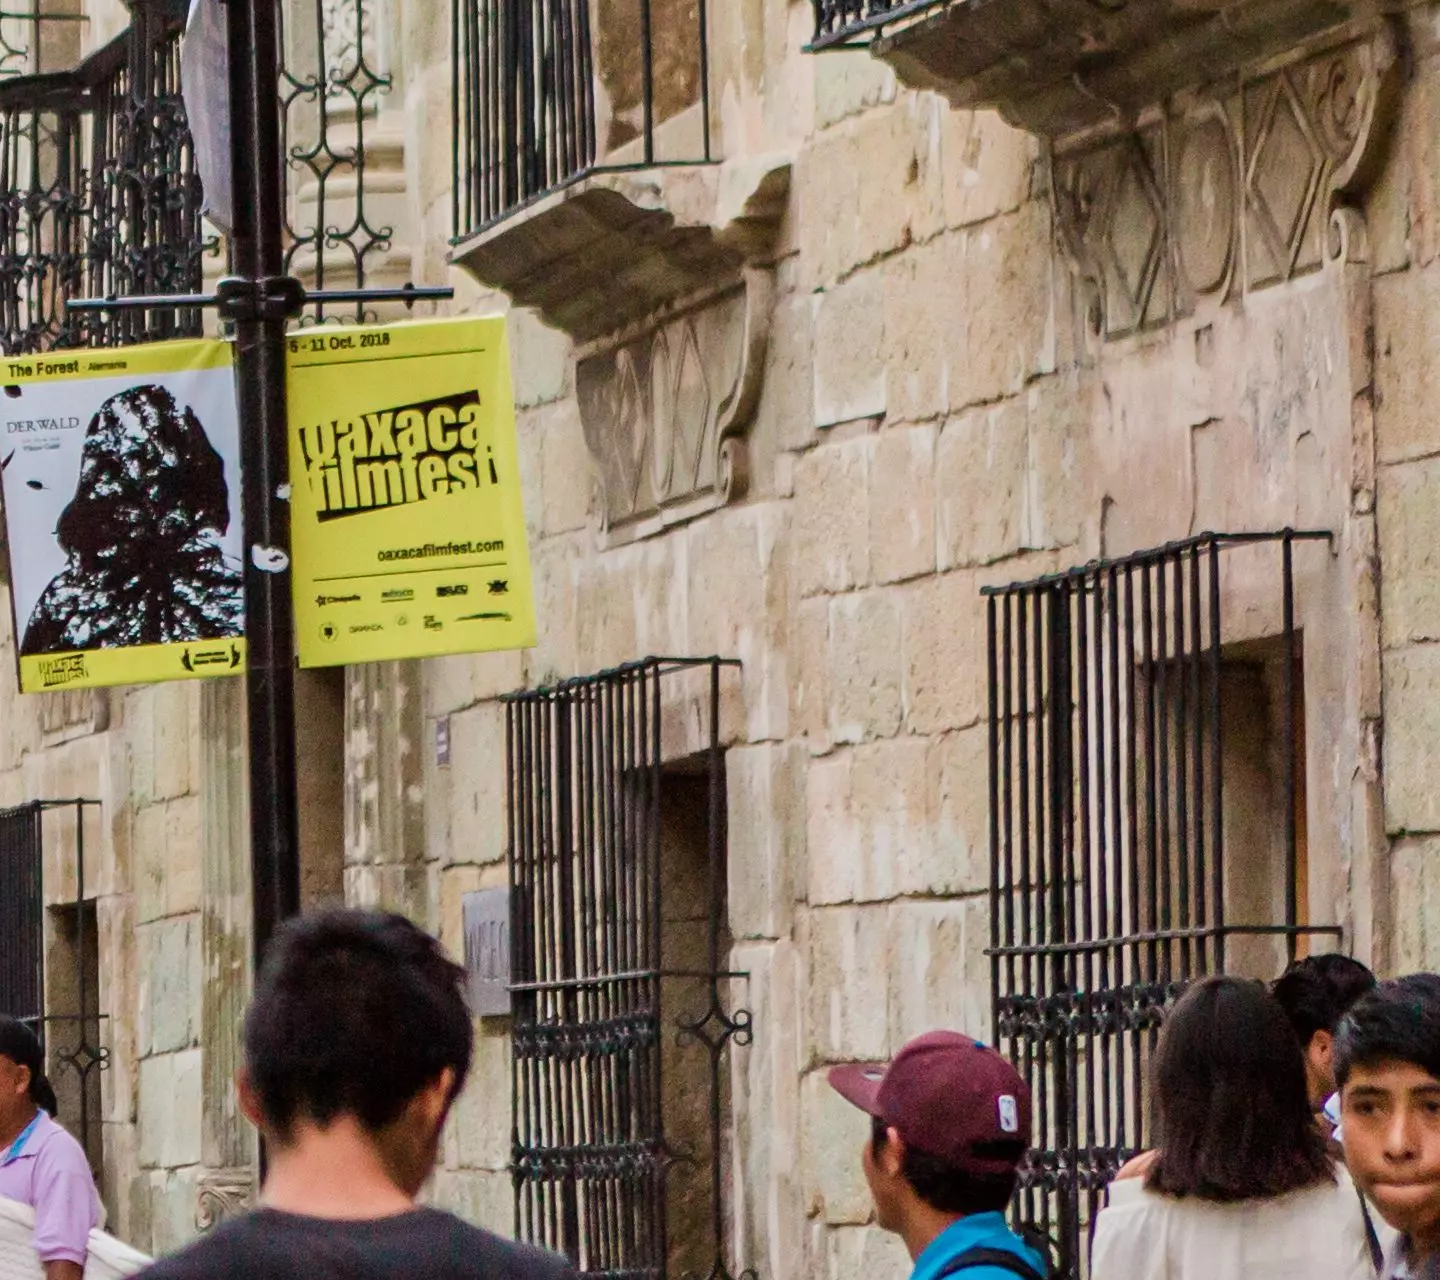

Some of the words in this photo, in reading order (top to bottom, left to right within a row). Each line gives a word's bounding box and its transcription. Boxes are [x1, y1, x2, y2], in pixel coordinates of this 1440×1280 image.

[311, 338, 325, 351] 11
[330, 336, 356, 350] Oct.
[360, 333, 390, 348] 2018
[8, 363, 33, 377] The
[36, 360, 80, 376] Forest
[7, 421, 34, 434] DER
[36, 417, 80, 431] WALD
[308, 447, 499, 517] filmfest
[377, 540, 505, 562] oaxacafilmfest.com
